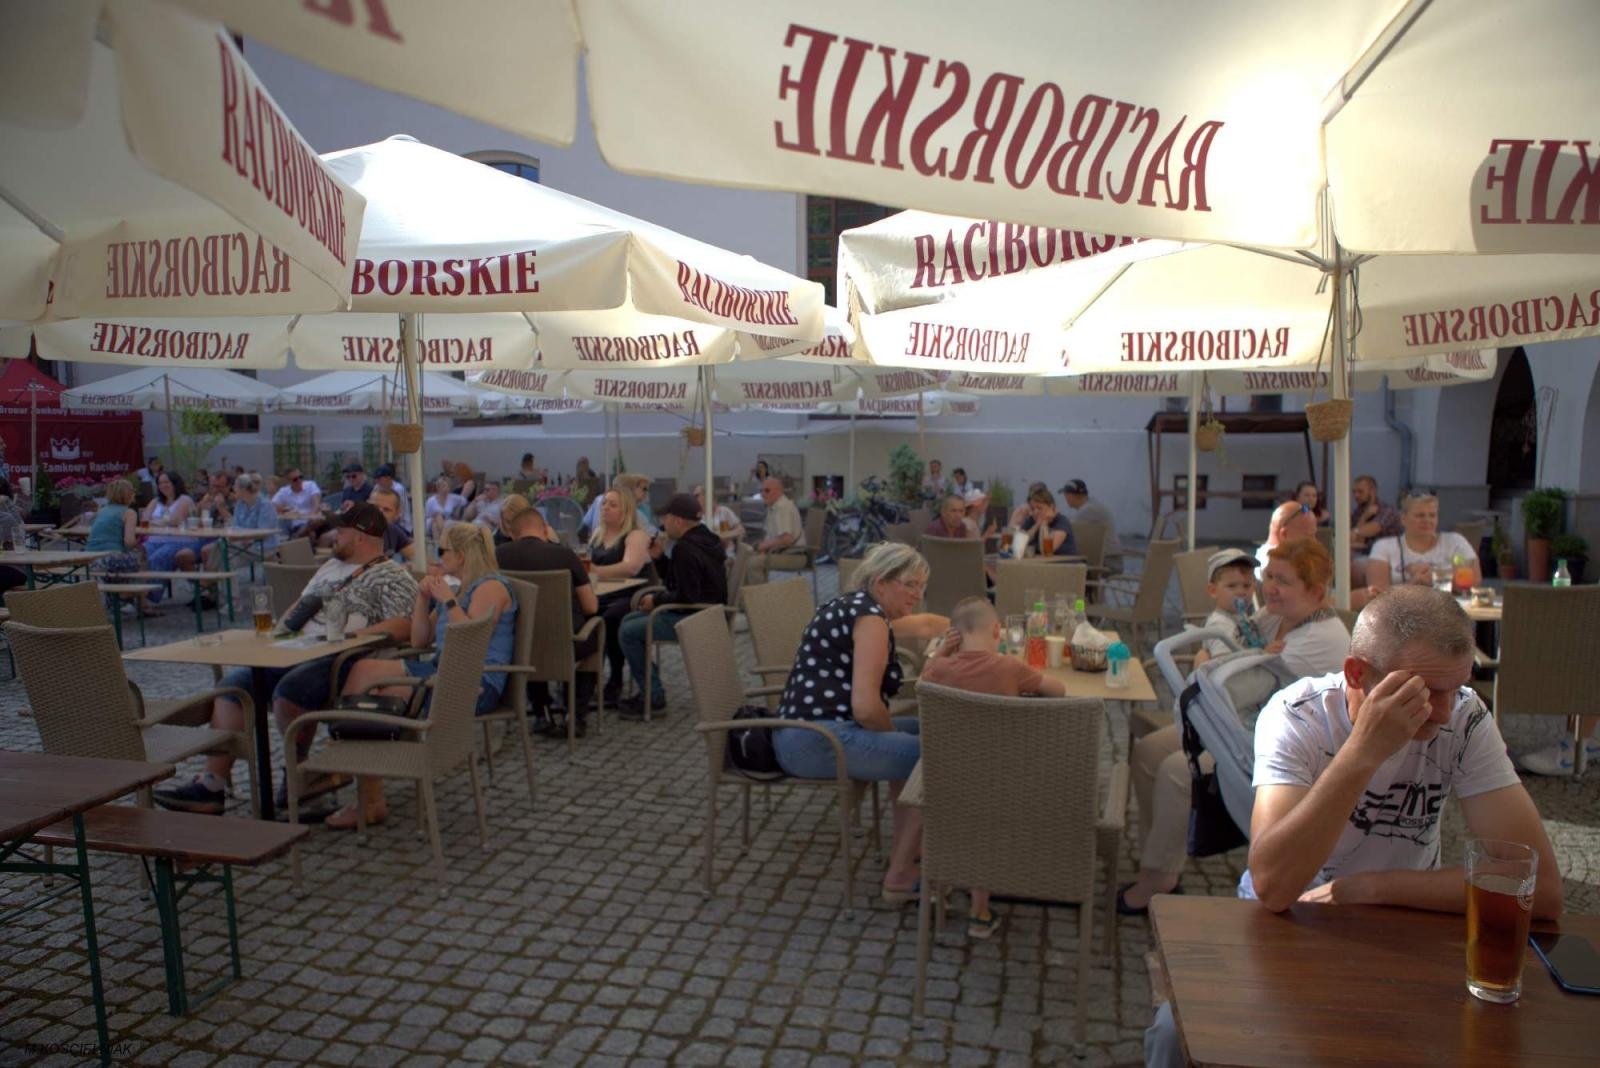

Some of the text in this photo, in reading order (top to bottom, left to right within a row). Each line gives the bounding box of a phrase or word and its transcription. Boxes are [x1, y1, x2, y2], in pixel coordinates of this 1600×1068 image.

[350, 250, 540, 296] BORSKIE
[910, 220, 1151, 289] RACIBOR
[677, 259, 798, 326] RACIBORSKIE
